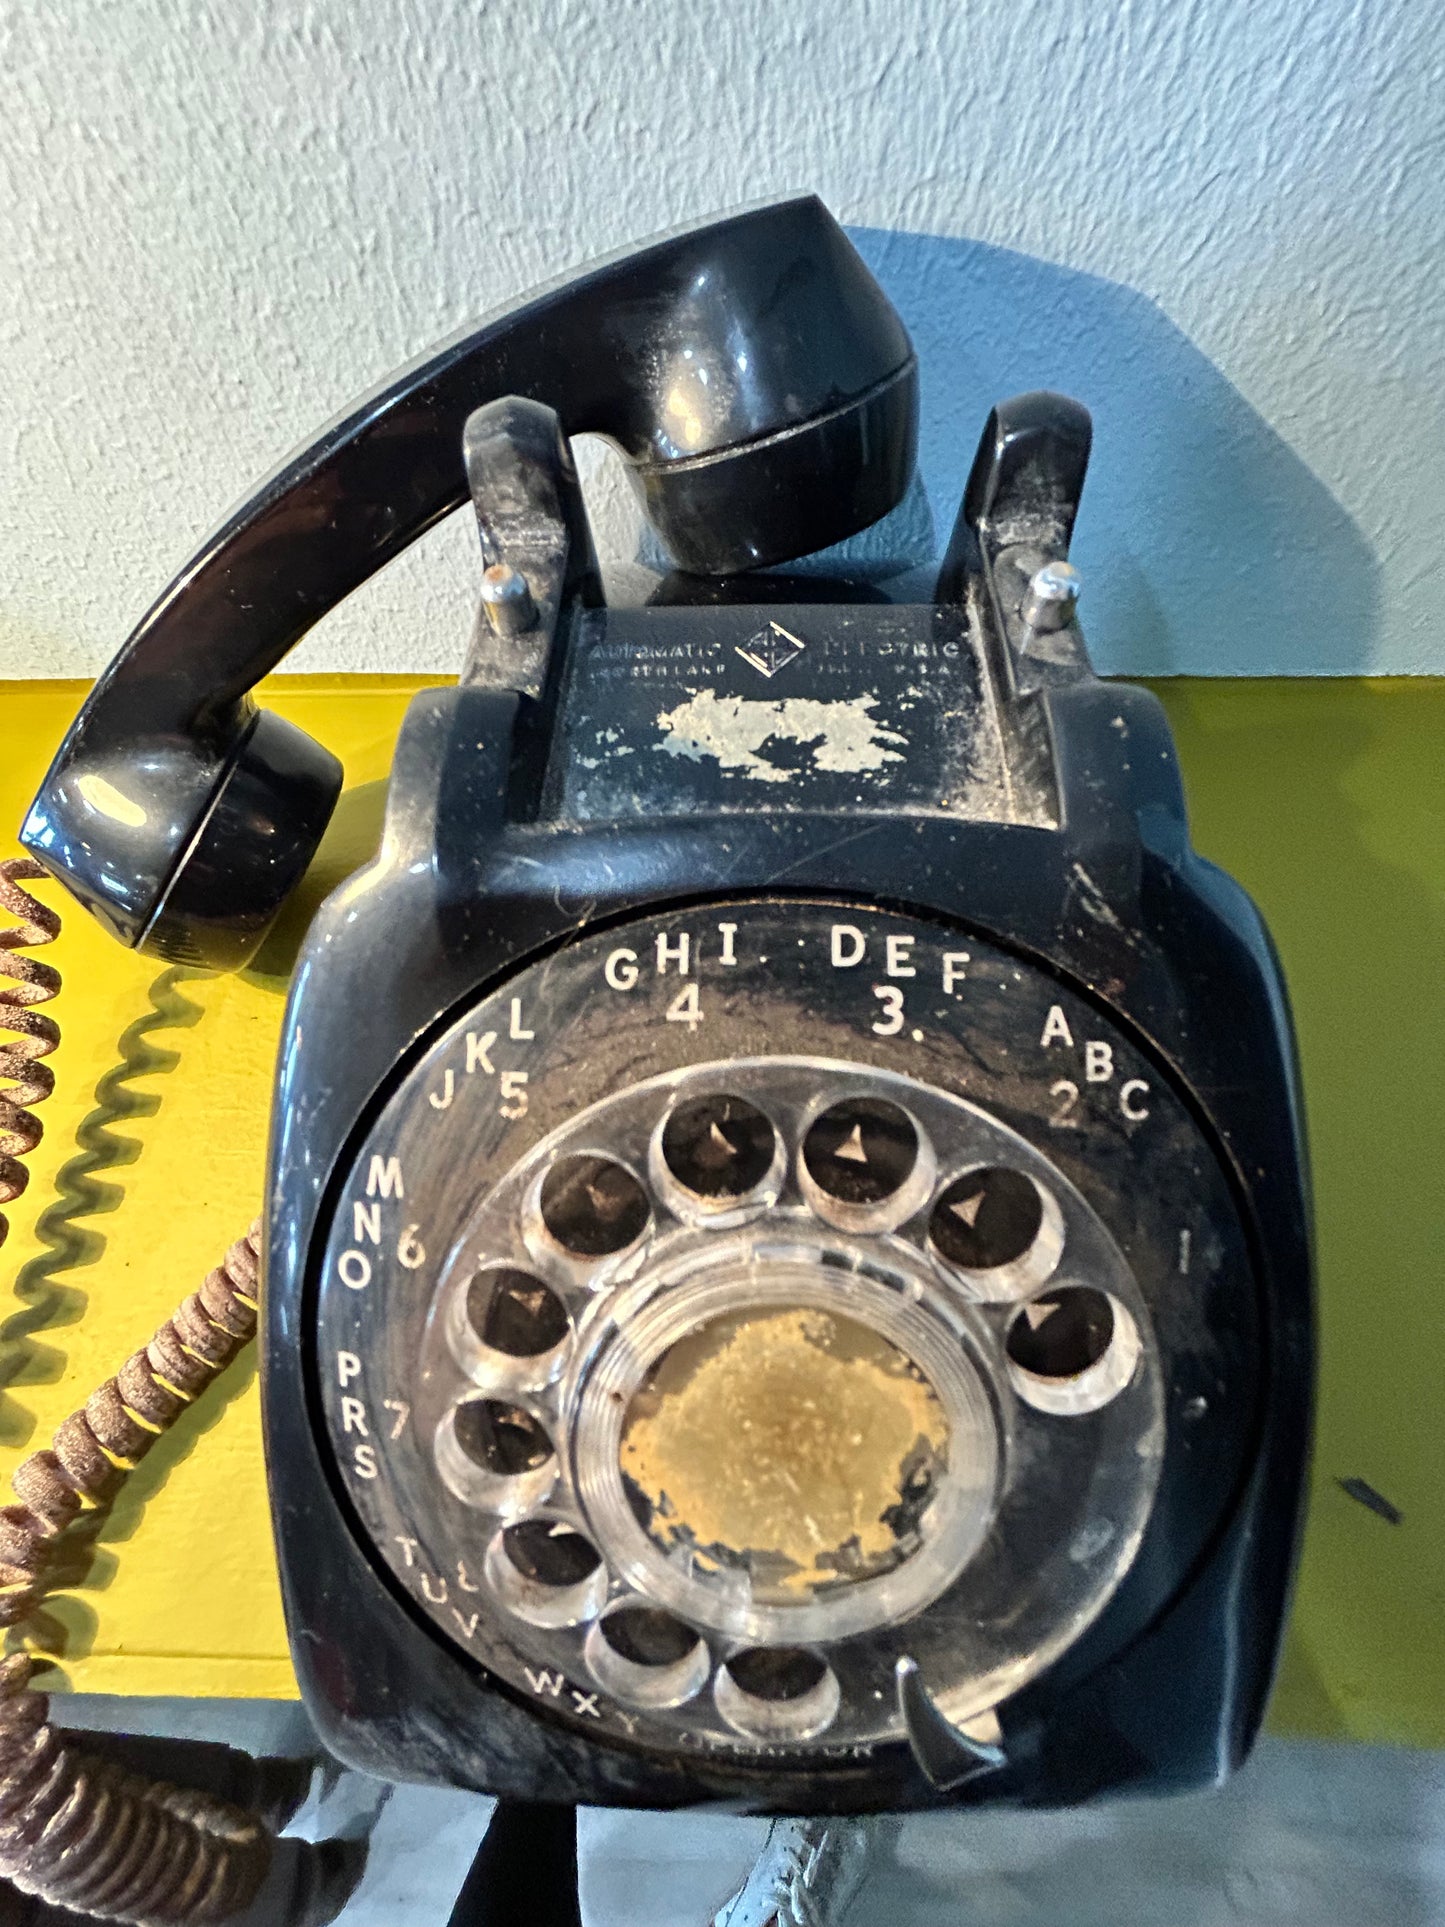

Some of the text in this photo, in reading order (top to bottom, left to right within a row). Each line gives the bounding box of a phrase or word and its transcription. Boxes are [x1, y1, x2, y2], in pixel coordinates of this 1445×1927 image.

[665, 983, 705, 1032] 4
[871, 985, 905, 1036] 3
[500, 1071, 529, 1120] 5
[1048, 1080, 1080, 1129] 2
[397, 1222, 427, 1270] 6
[383, 1399, 411, 1440] 7
